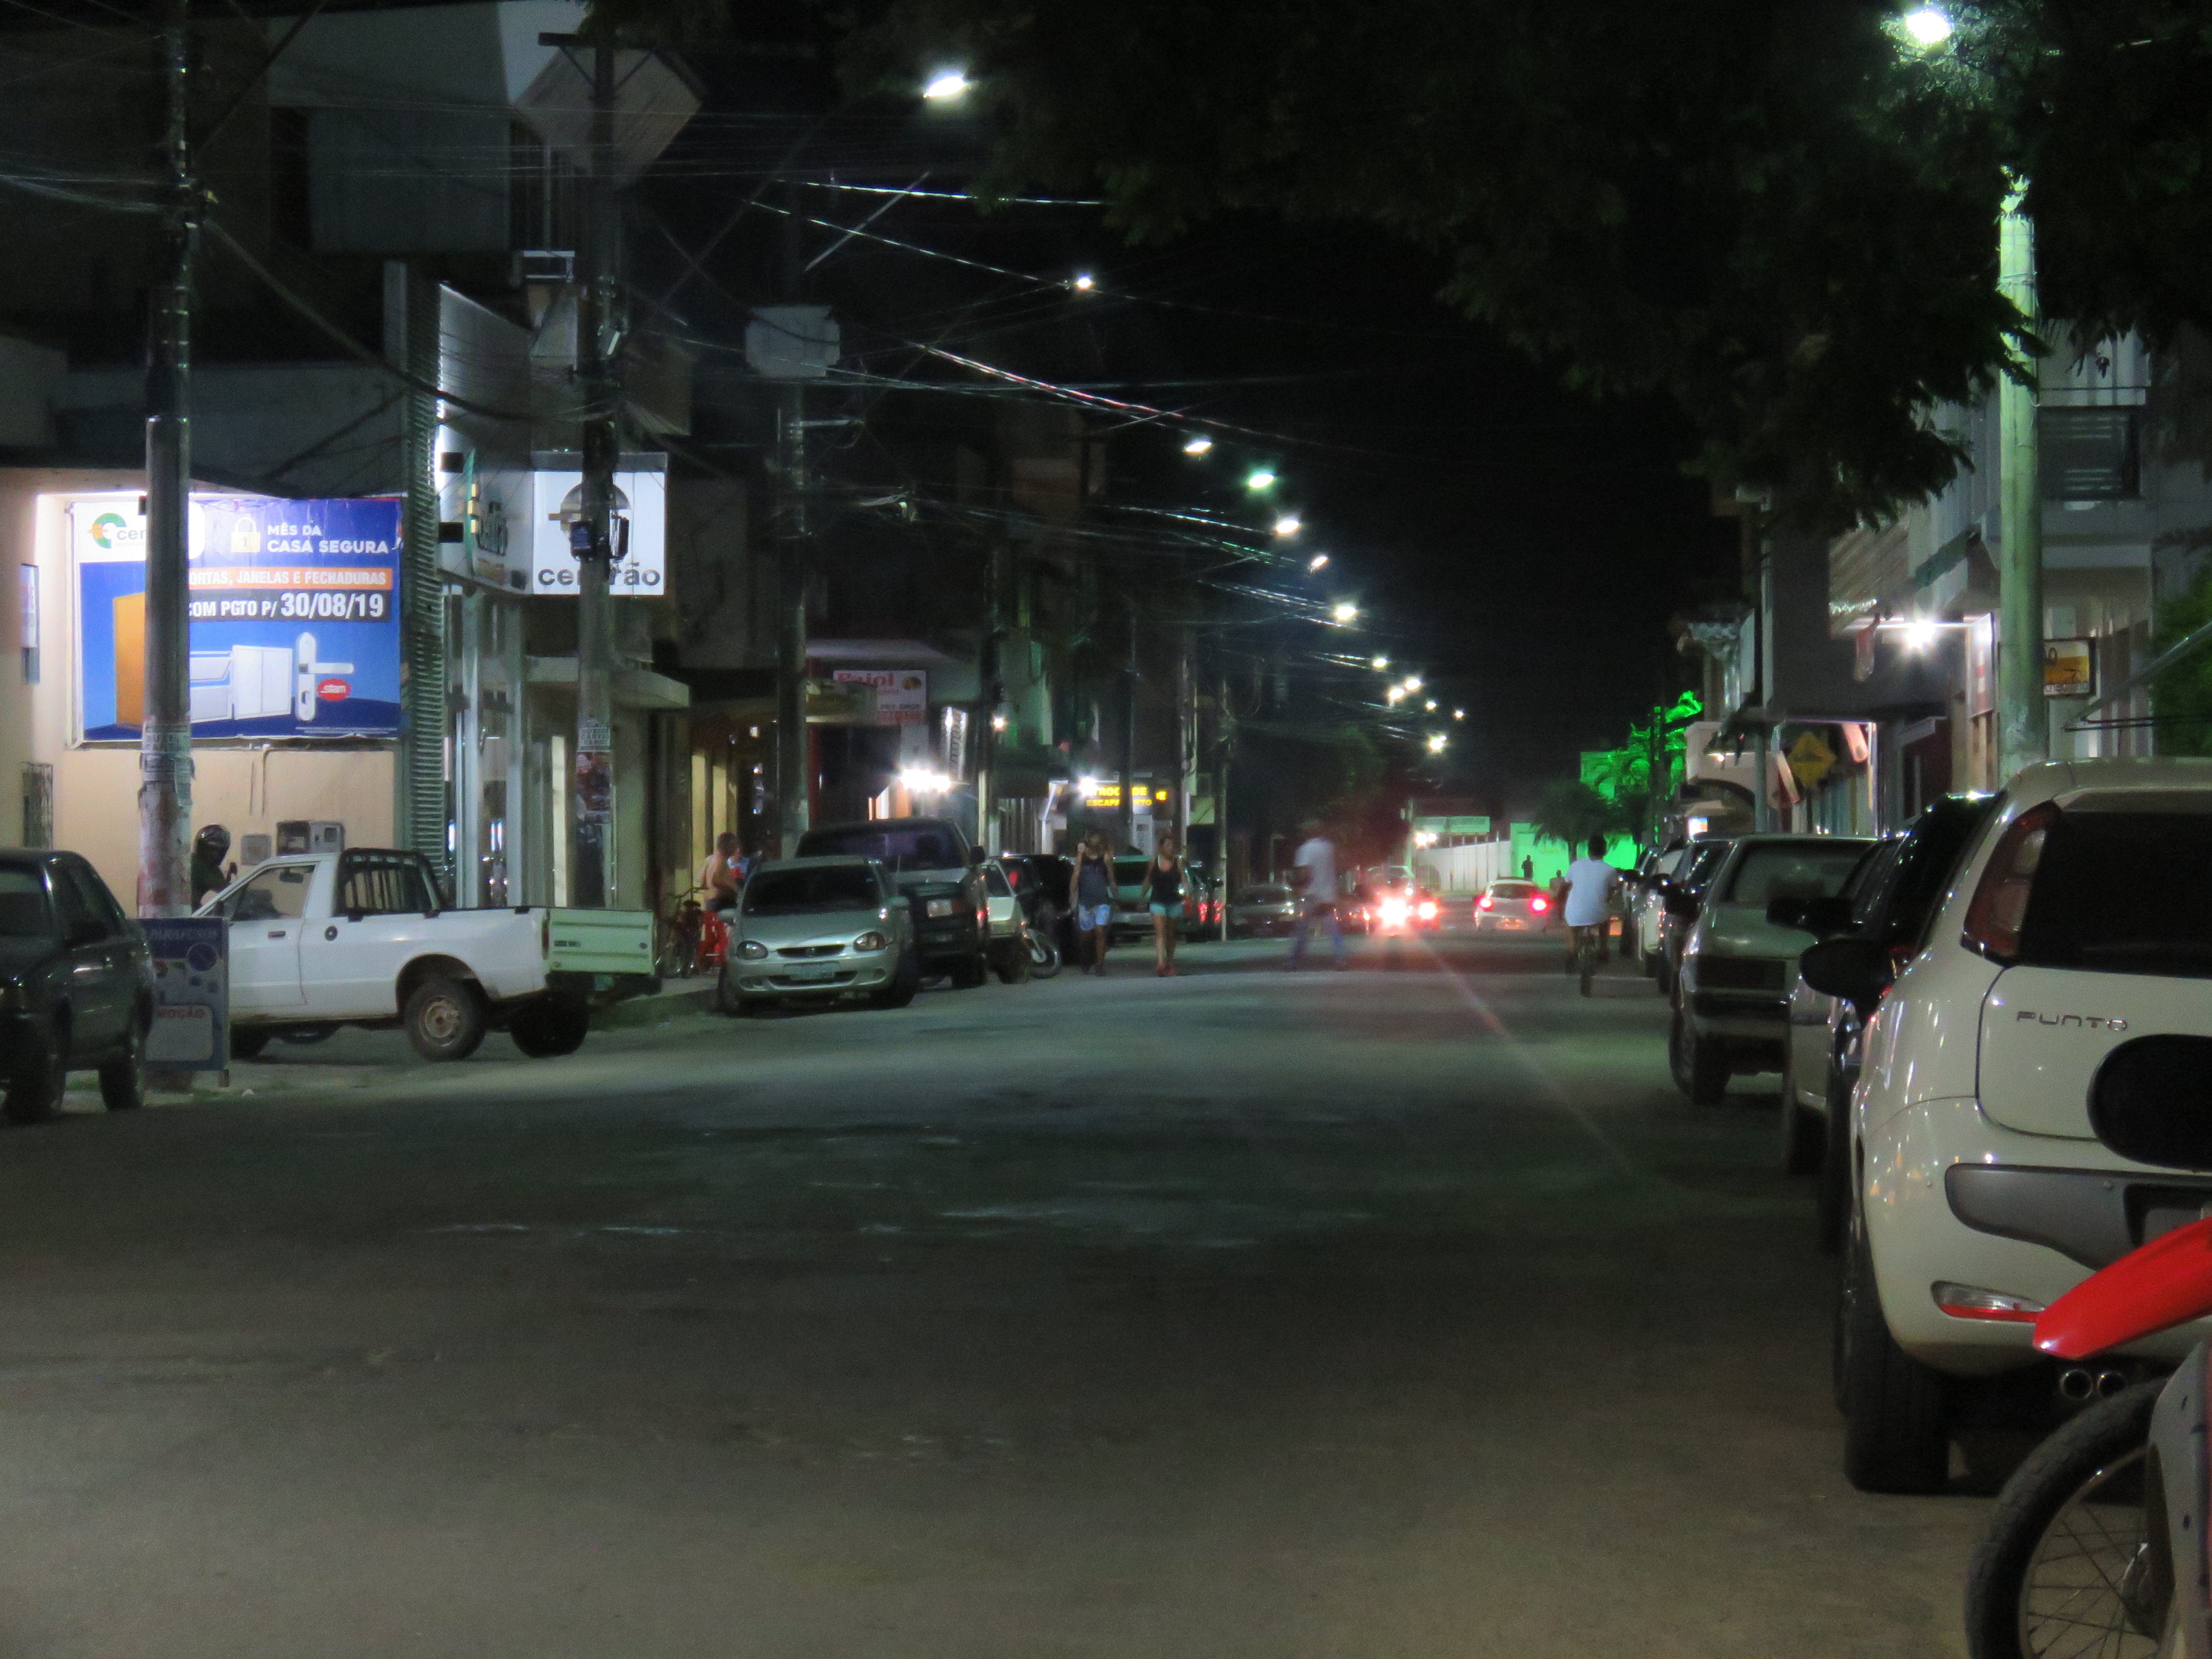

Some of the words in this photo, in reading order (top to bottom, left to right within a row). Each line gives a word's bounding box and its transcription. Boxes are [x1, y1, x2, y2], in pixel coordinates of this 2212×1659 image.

[267, 523, 297, 536] MÊS
[302, 524, 322, 536] DA
[267, 540, 313, 553] CASA
[319, 540, 388, 554] SEGURA
[190, 571, 232, 585] ORTAS,
[237, 571, 289, 585] JANELAS
[293, 571, 301, 584] E
[305, 571, 386, 586] FECHADURAS
[538, 561, 661, 586] cerão
[189, 601, 216, 617] OM
[221, 601, 257, 617] PGTO
[262, 601, 278, 618] P/
[280, 592, 383, 620] 30/08/19
[1131, 786, 1148, 796] DE
[2016, 1010, 2128, 1032] PUNTO
